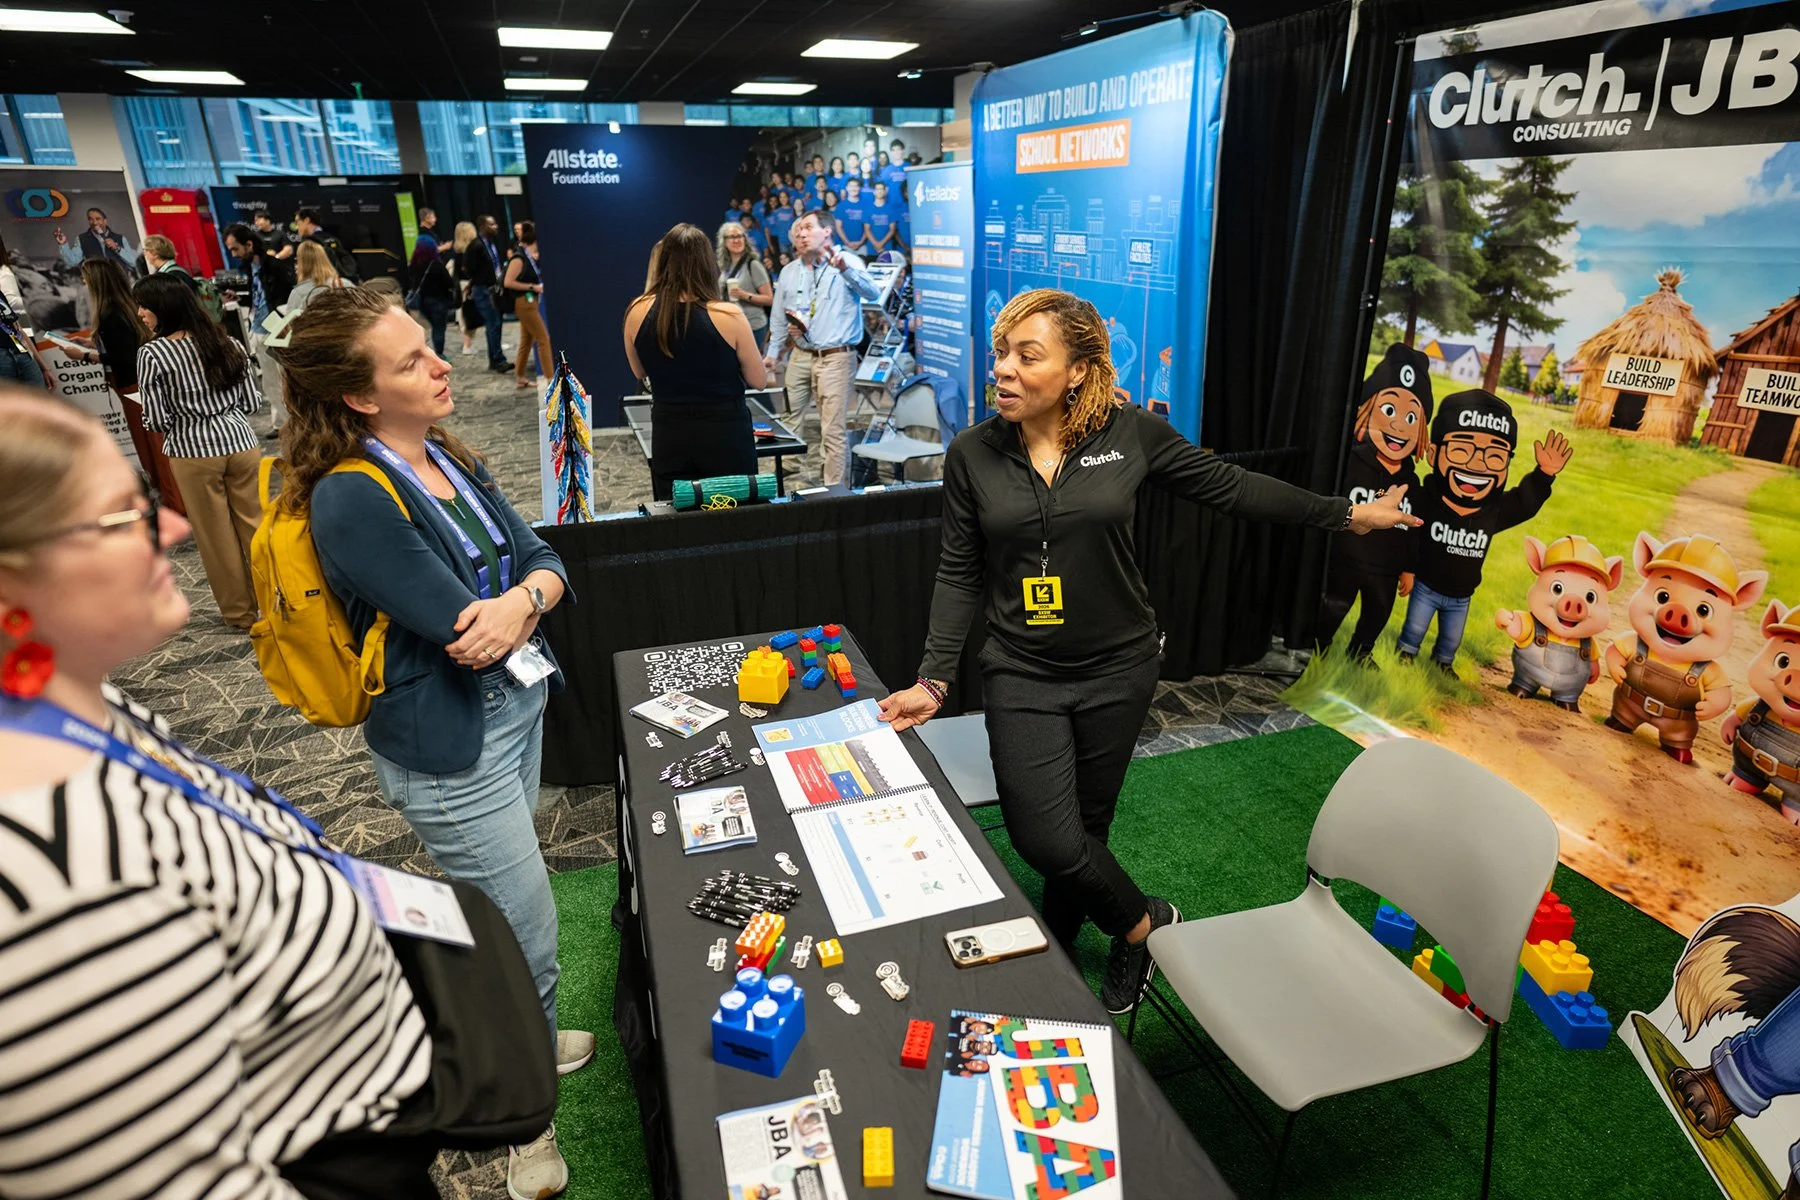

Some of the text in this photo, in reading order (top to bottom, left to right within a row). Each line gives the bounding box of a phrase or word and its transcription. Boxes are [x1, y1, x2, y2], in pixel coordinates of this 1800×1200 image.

[1429, 28, 1800, 129] Clutch. JB
[989, 98, 1024, 131] BETTER
[1024, 92, 1047, 125] WAY
[1048, 89, 1061, 122] TO
[1063, 81, 1097, 119] BUILD
[1099, 74, 1127, 113] AND
[1513, 118, 1632, 143] CONSULTING
[1019, 124, 1126, 167] SCHOOL NETWORKS
[543, 149, 618, 169] Allstate
[552, 171, 620, 184] Foundation
[1626, 357, 1661, 374] BUILD
[1607, 370, 1675, 392] LEADERSHIP
[1766, 373, 1800, 392] BUIL
[1458, 409, 1510, 435] Clutch
[1431, 521, 1488, 549] Clutch
[1446, 545, 1484, 559] CONSULTING
[993, 1016, 1116, 1200] JBA
[767, 1115, 792, 1160] JBA
